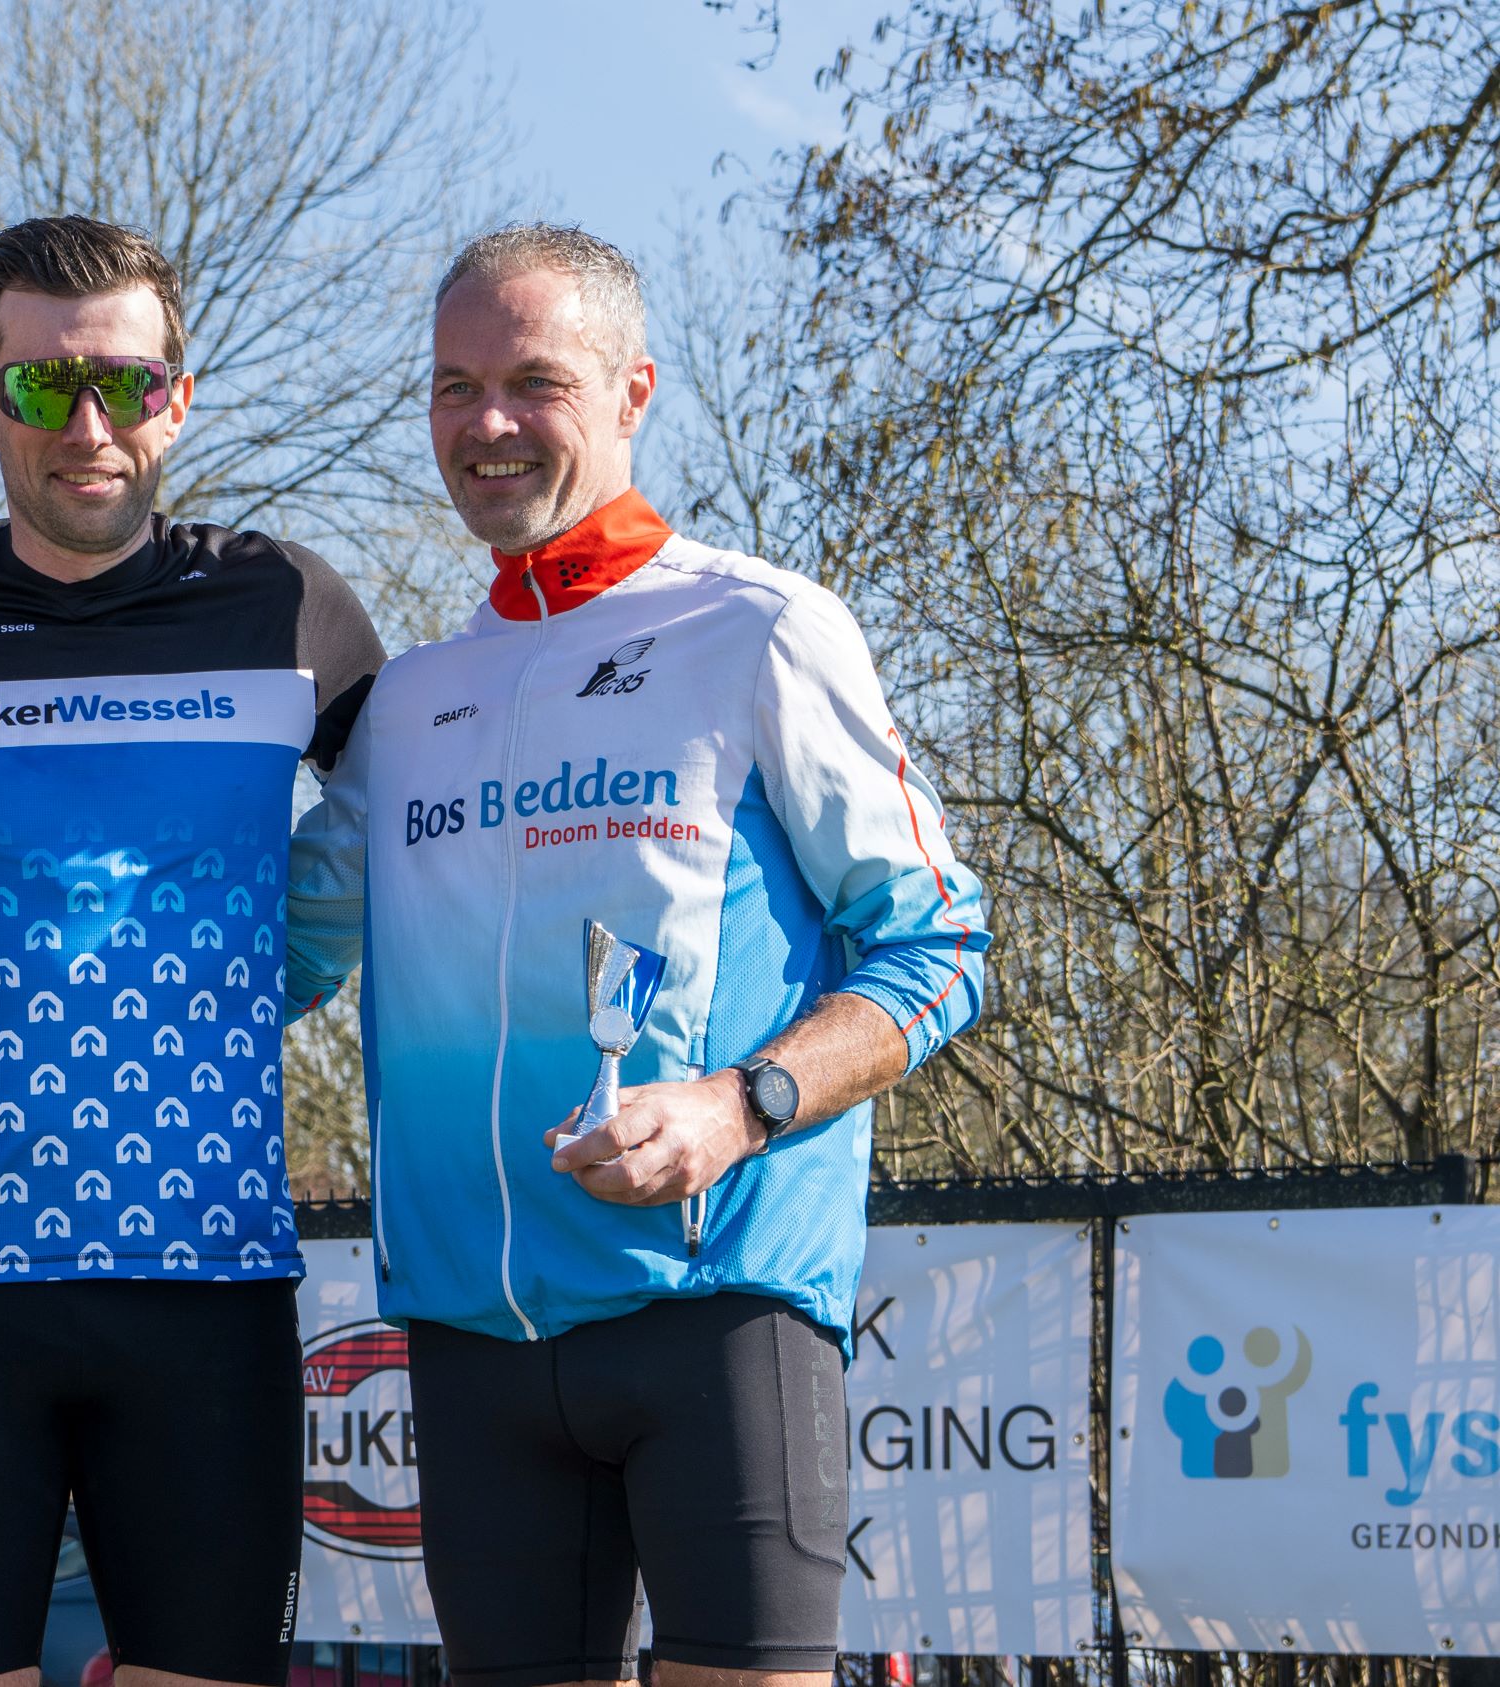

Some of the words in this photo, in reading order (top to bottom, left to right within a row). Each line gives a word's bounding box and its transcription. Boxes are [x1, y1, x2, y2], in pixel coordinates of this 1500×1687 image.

[433, 705, 471, 727] CRAFT
[406, 798, 465, 847] Bos
[480, 757, 681, 828] Bedden
[525, 822, 598, 849] Droom
[606, 816, 700, 842] bedden
[810, 1336, 840, 1529] NORTH
[279, 1571, 297, 1643] FUSION
